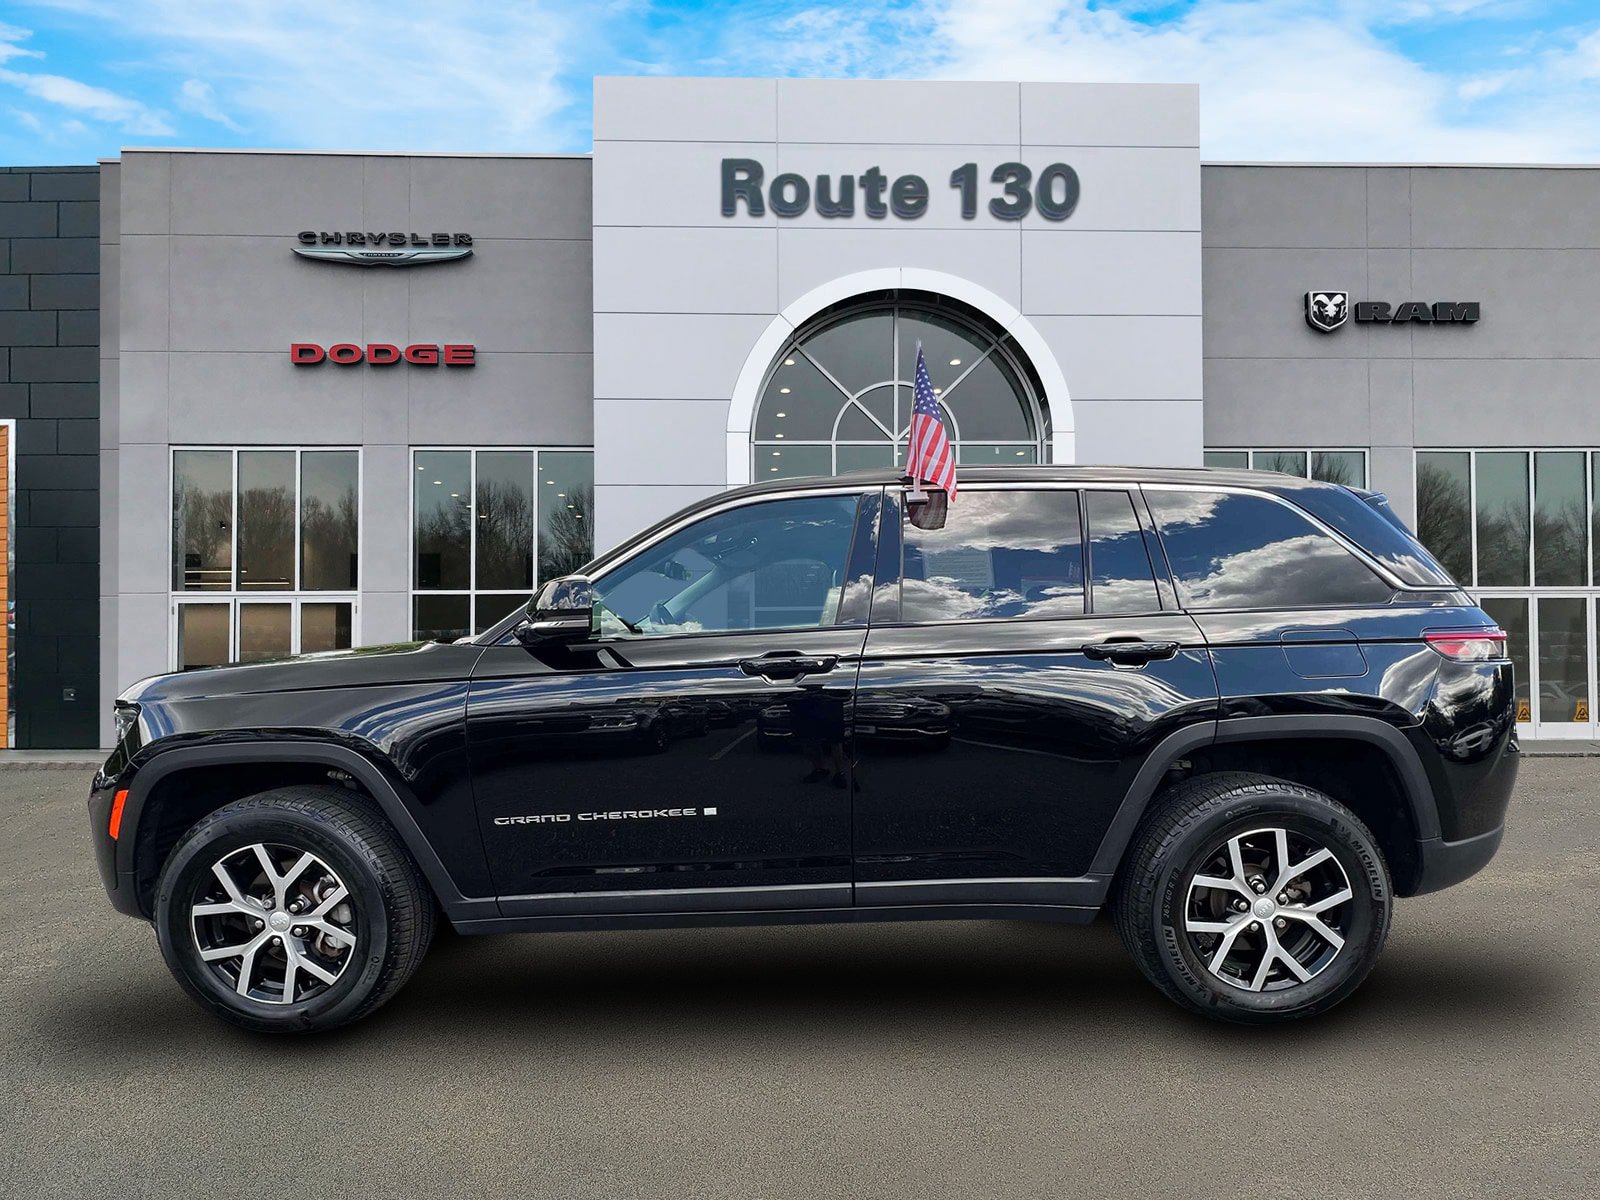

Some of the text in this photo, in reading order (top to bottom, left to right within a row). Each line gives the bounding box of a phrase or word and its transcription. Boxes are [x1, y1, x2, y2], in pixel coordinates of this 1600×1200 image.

[721, 158, 1081, 221] Route 130
[298, 231, 473, 244] CHRYSLER
[1355, 302, 1480, 322] RAM
[291, 343, 475, 365] DODGE
[494, 807, 697, 826] GRAND CHEROKEE
[1351, 840, 1383, 898] MICHELIN
[1164, 928, 1197, 986] MICHELIN
